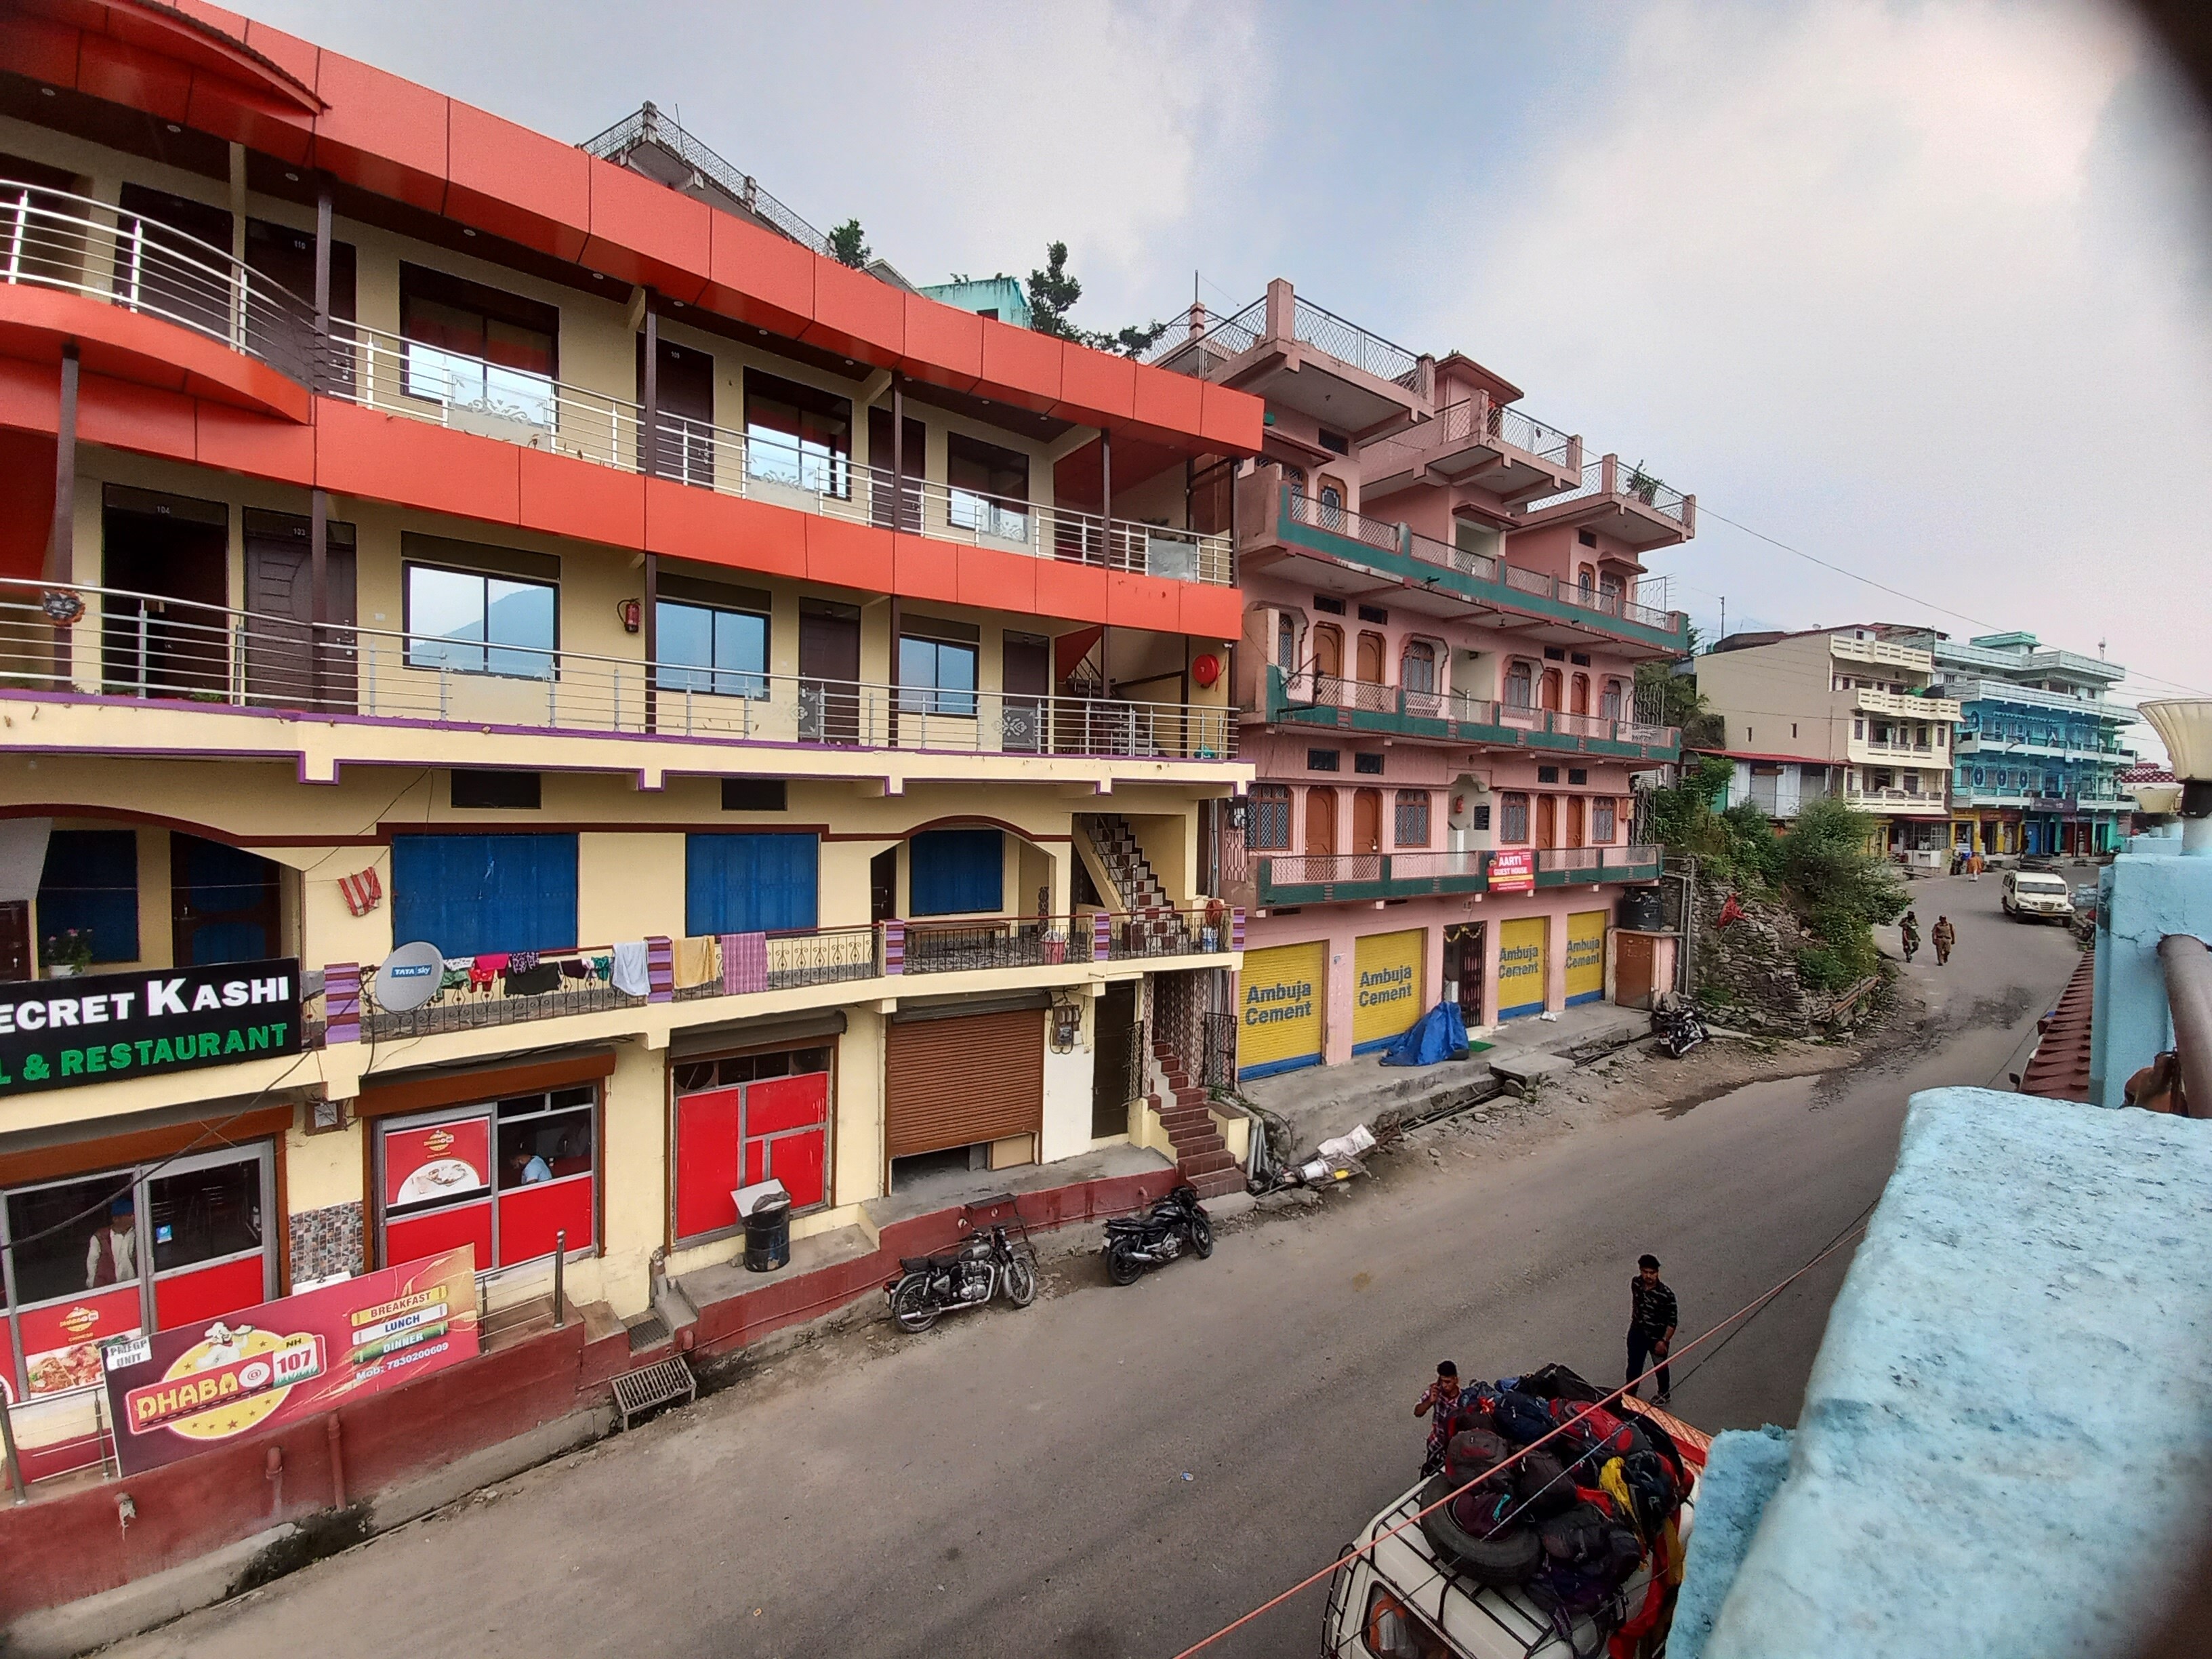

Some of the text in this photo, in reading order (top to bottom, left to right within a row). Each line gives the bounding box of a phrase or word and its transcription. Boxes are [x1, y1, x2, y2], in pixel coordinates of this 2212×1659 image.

[1498, 855, 1522, 867] AARTI
[1498, 944, 1538, 962] Ambuja
[1359, 965, 1412, 987] Ambuja
[147, 976, 289, 1017] KASHI
[1246, 980, 1311, 1004] Ambuja
[1359, 983, 1412, 1007] Cement
[1246, 1001, 1311, 1025] Cement
[23, 1054, 50, 1081] &
[61, 1023, 287, 1076] RESTAURANT
[371, 1292, 432, 1318] BREAKFAST
[385, 1314, 420, 1333] LUNCH
[286, 1337, 302, 1348] NH
[383, 1332, 424, 1353] DINNER
[356, 1365, 385, 1380] Mob:
[136, 1372, 239, 1420] DHABA
[276, 1349, 312, 1374] 107
